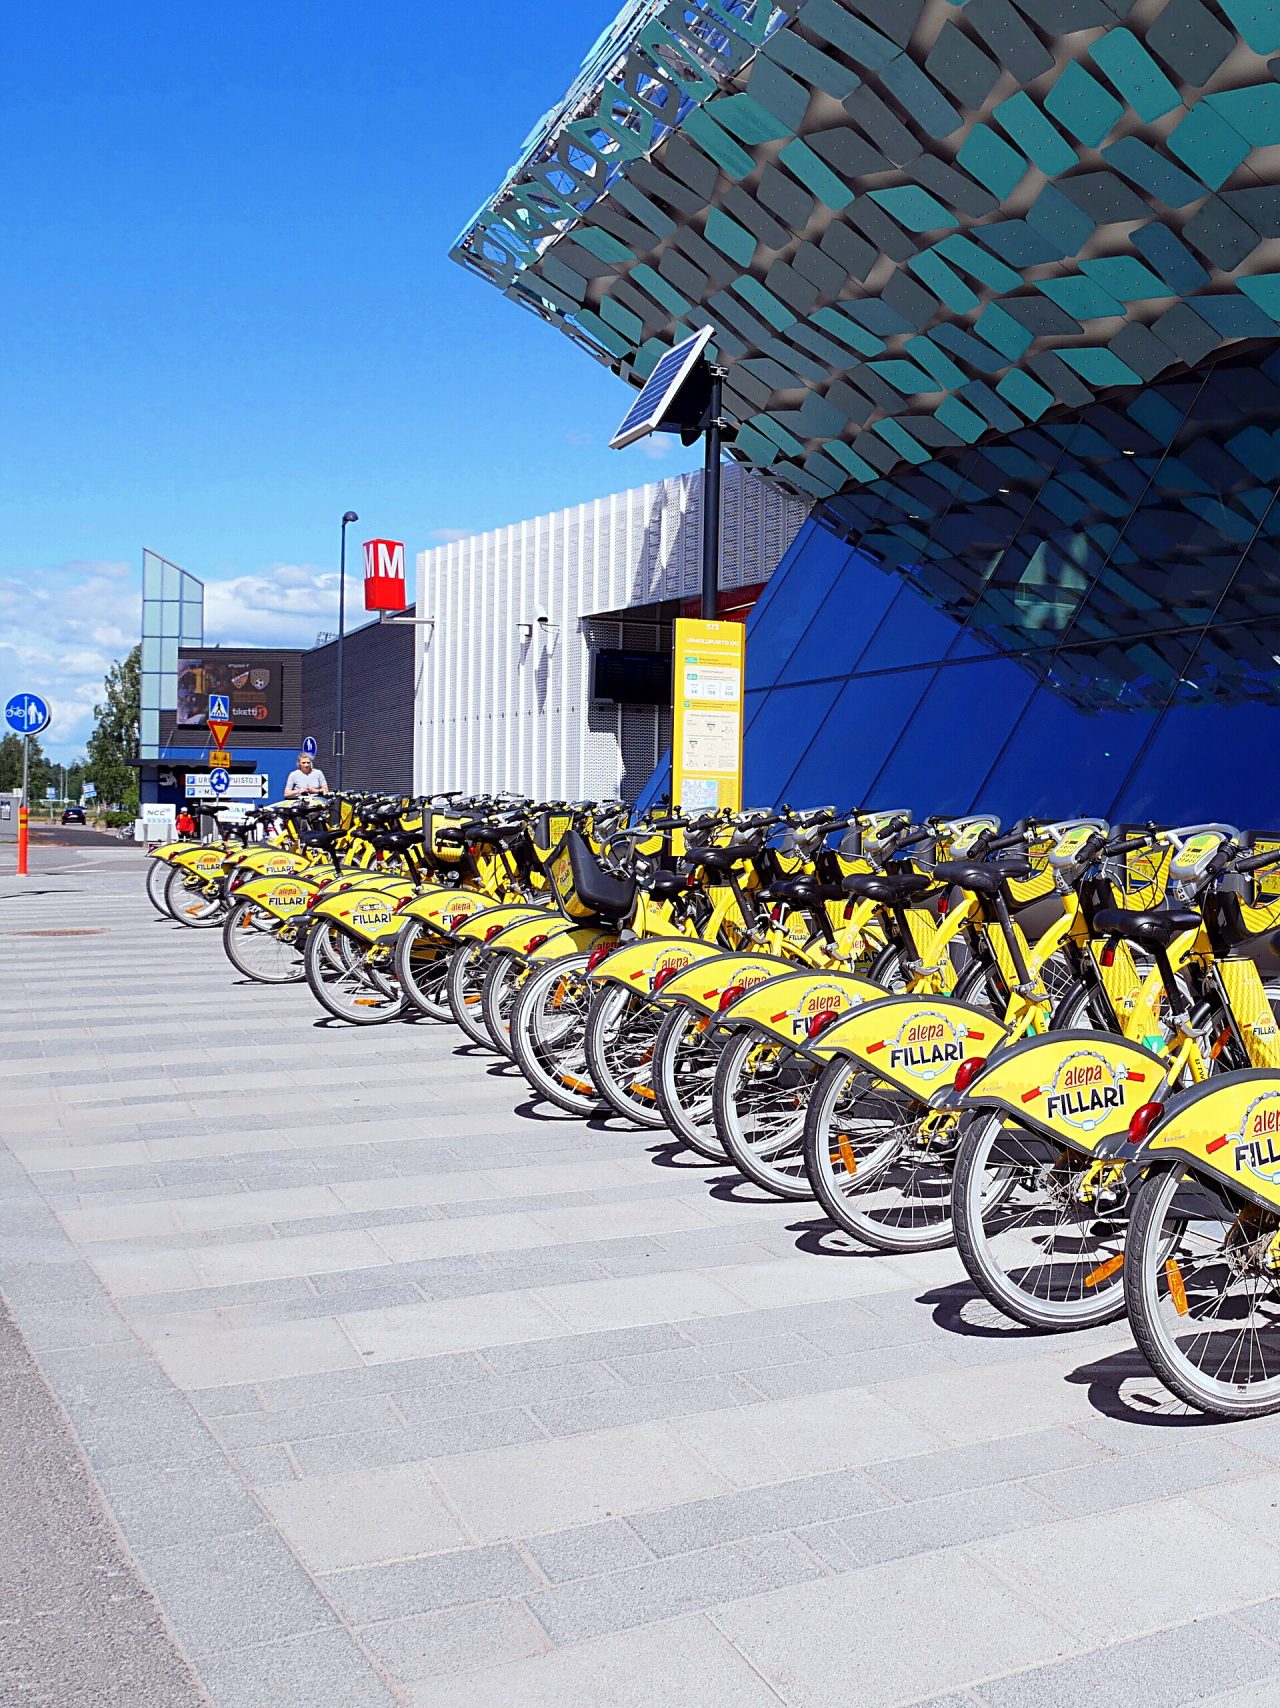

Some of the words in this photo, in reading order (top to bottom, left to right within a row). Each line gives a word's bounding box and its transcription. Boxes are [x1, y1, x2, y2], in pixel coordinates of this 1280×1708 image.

[377, 543, 404, 580] M
[268, 896, 305, 906] FILLARI
[451, 902, 471, 911] alepa
[352, 912, 392, 925] FILLARI
[661, 955, 689, 969] alepa
[808, 994, 841, 1012] alepa
[908, 1022, 945, 1042] alepa
[890, 1041, 964, 1069] FILLARI
[1064, 1064, 1103, 1087] alepa
[1047, 1085, 1125, 1119] FILLARI
